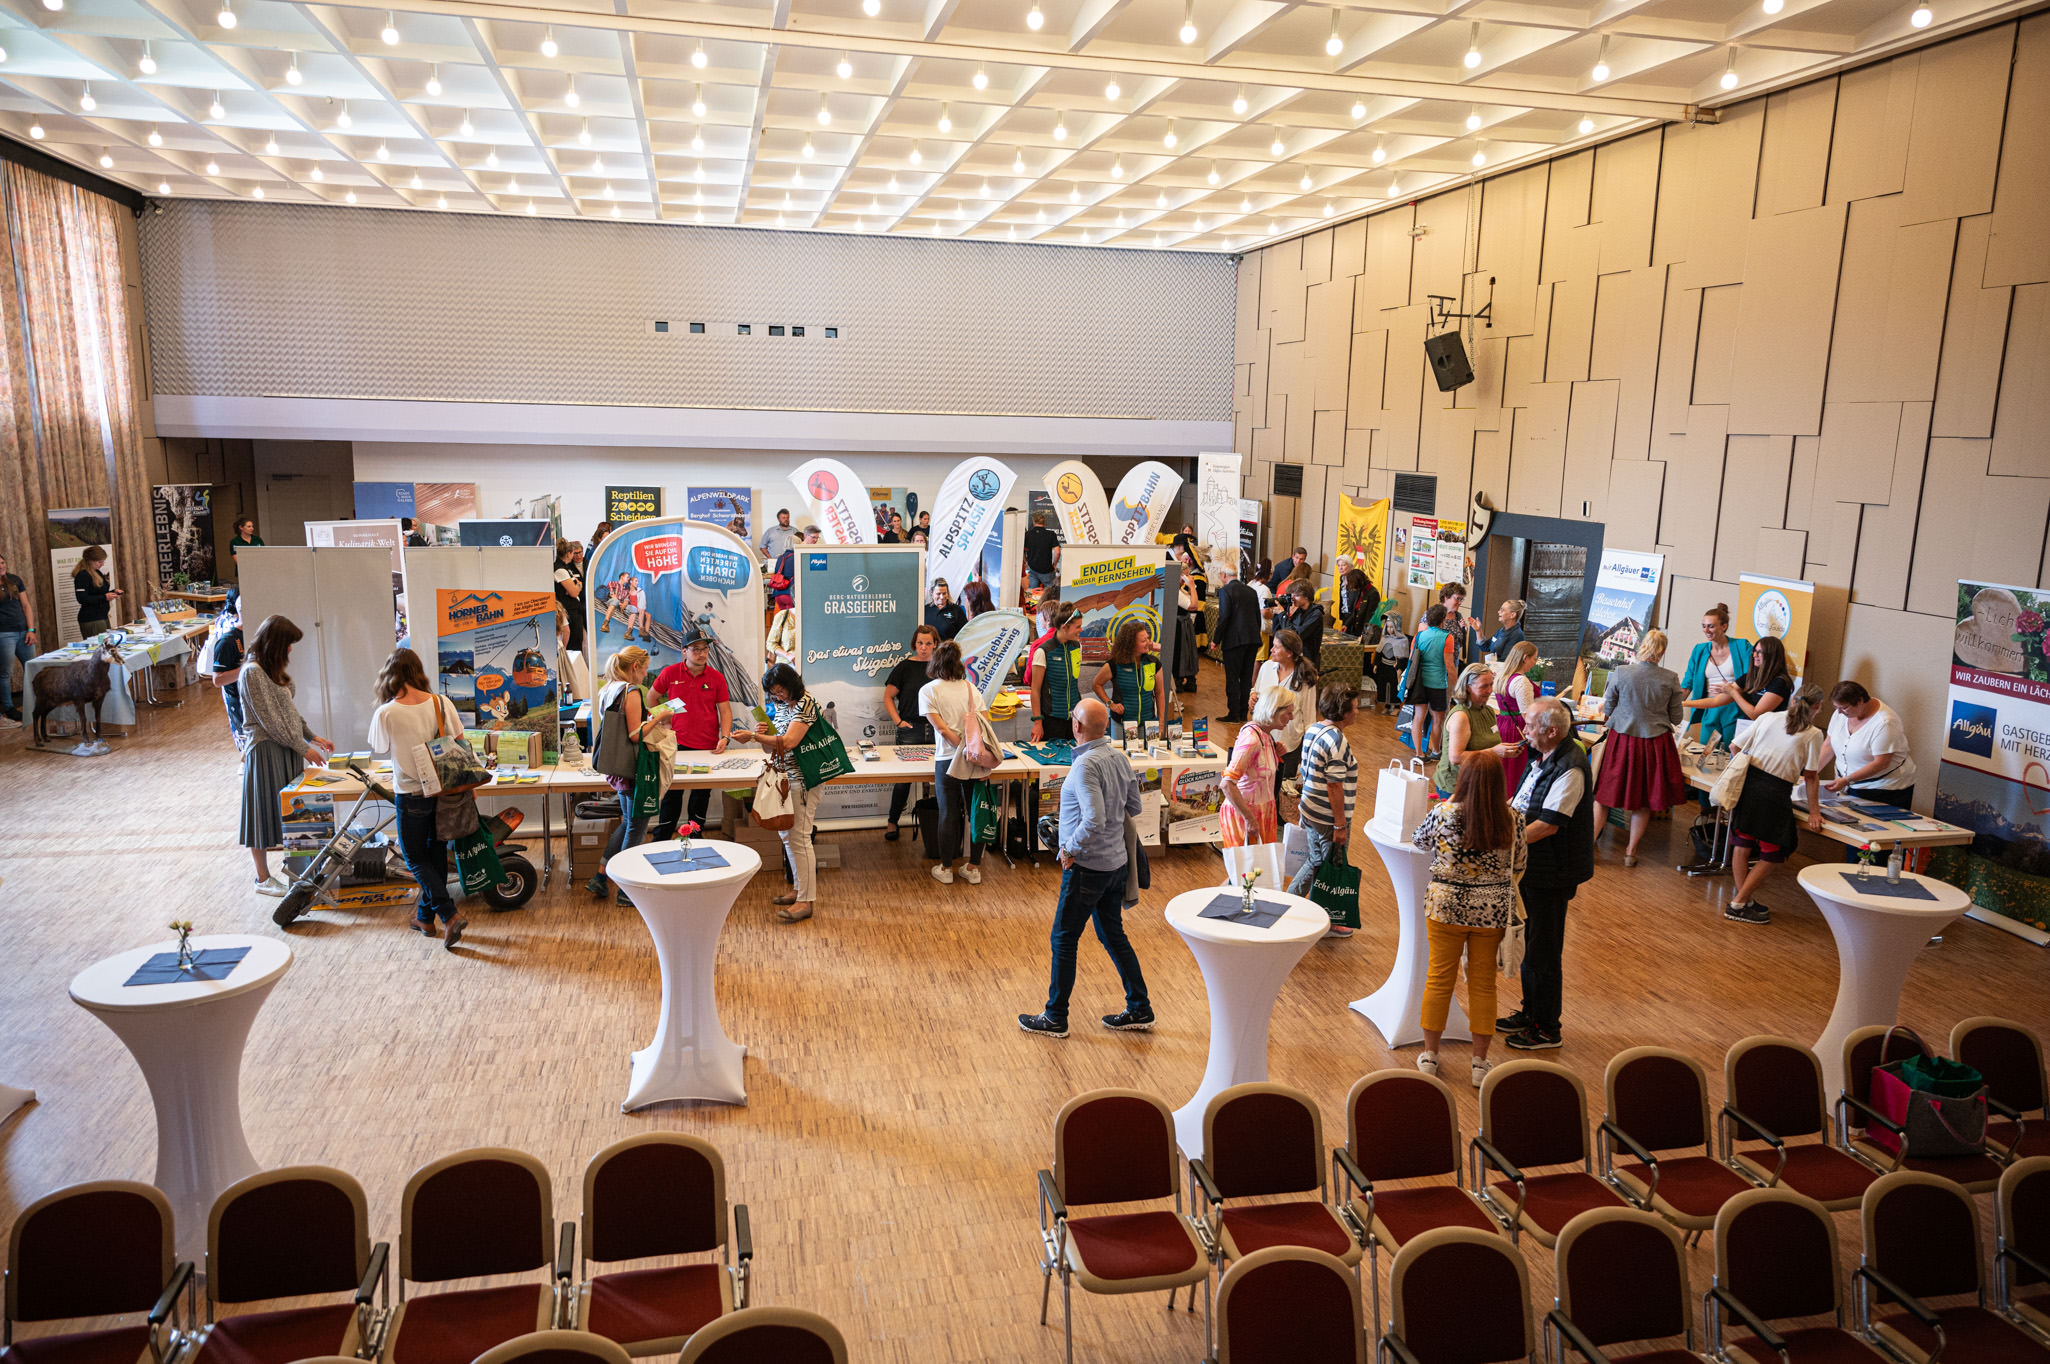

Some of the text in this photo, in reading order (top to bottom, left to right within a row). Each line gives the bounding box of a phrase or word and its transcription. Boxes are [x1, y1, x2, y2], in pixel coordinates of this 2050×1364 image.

[611, 490, 655, 501] Reptilien
[939, 497, 974, 559] ALPSPITZ
[956, 503, 986, 551] SPLASH
[647, 554, 679, 568] HÖHE
[1083, 558, 1133, 577] ENDLICH
[1611, 563, 1641, 575] Allgäuer
[1073, 567, 1154, 586] WIEDER FERNSEHEN.
[448, 603, 489, 620] HÖRNER
[476, 609, 504, 622] BAHN
[824, 600, 896, 614] GRASGEHREN
[807, 640, 902, 664] Das etwas andere
[977, 627, 1008, 672] Skigebiet
[1955, 670, 1972, 682] WIR
[1972, 674, 2011, 690] ZAUBERN
[2013, 682, 2028, 693] EIN
[1952, 718, 1992, 739] Allgäu
[2001, 738, 2050, 762] MIT HERZ
[1313, 879, 1331, 891] Echt
